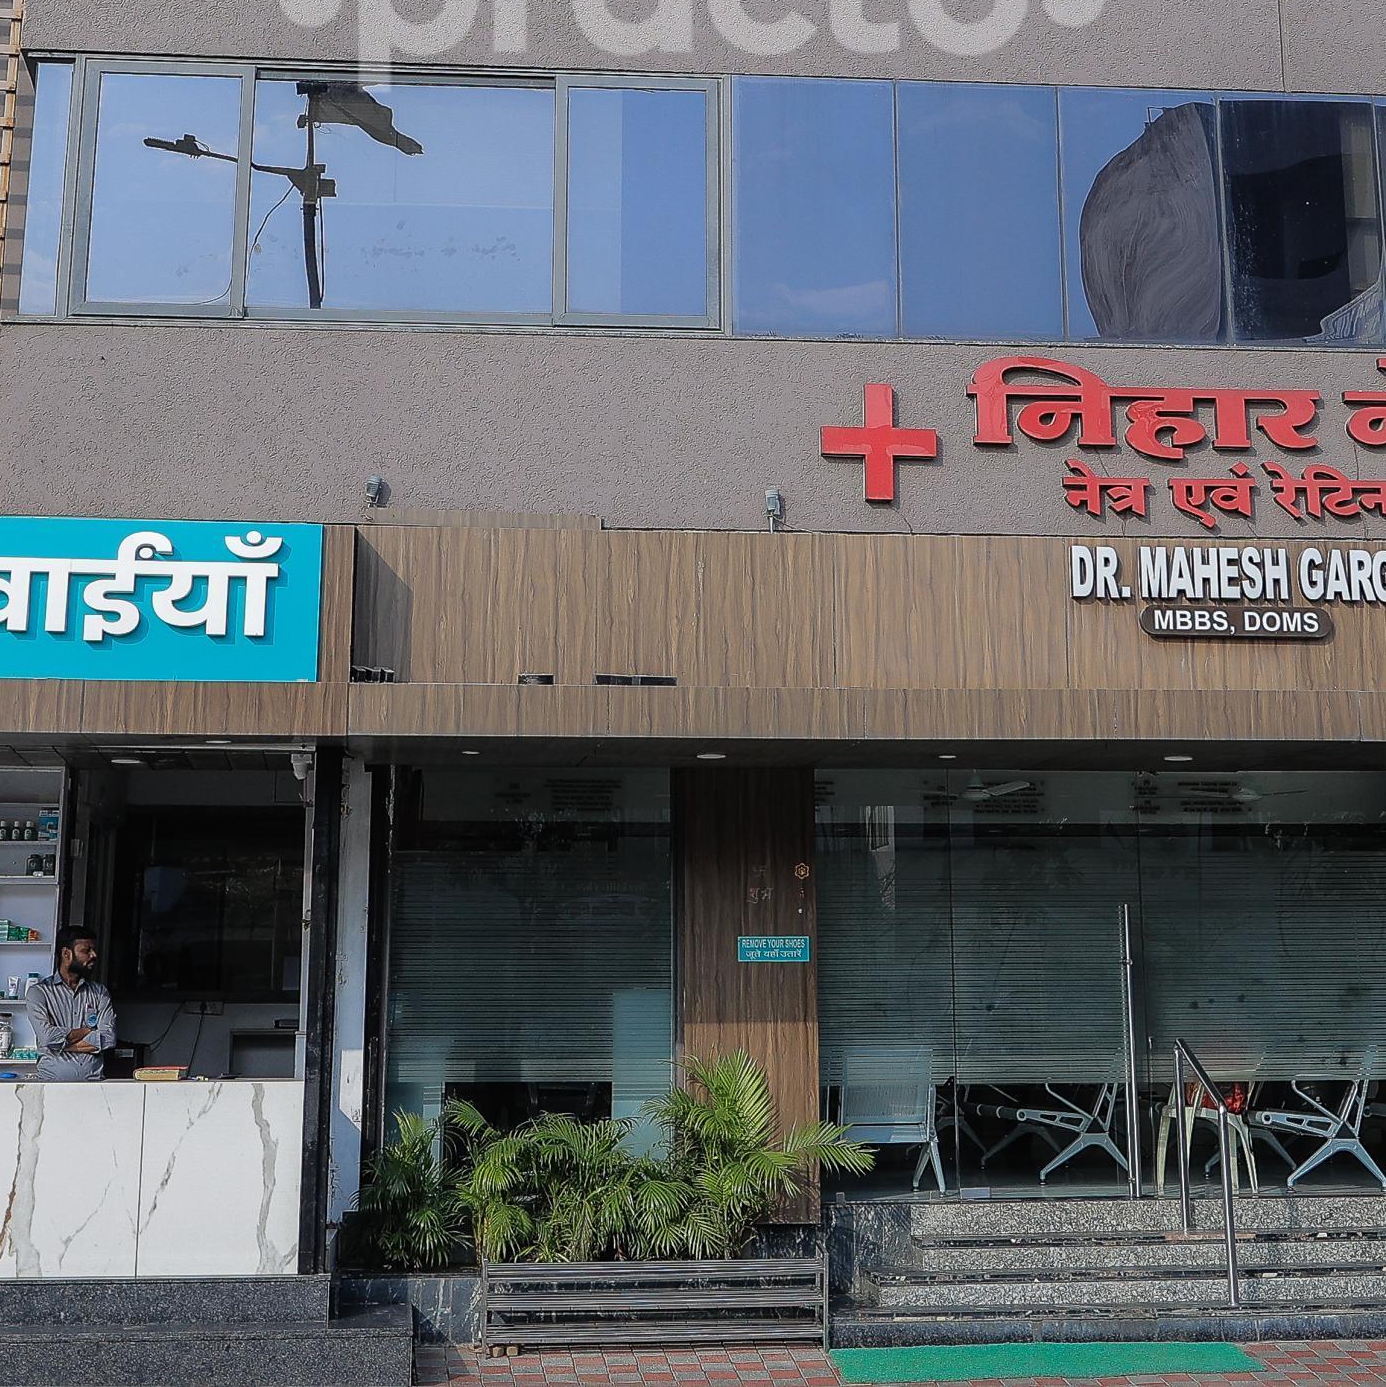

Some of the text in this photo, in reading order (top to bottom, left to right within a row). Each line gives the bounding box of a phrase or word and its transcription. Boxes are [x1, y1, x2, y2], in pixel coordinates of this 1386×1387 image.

[968, 355, 1321, 461] निहार
[1064, 459, 1150, 516] नेत्र
[1169, 462, 1256, 527] एवं
[1071, 545, 1131, 599] DR.
[1140, 546, 1290, 602] MAHESH
[1154, 610, 1320, 635] MBBS, DOMS
[741, 939, 806, 949] REMOVE YOUR SHOES
